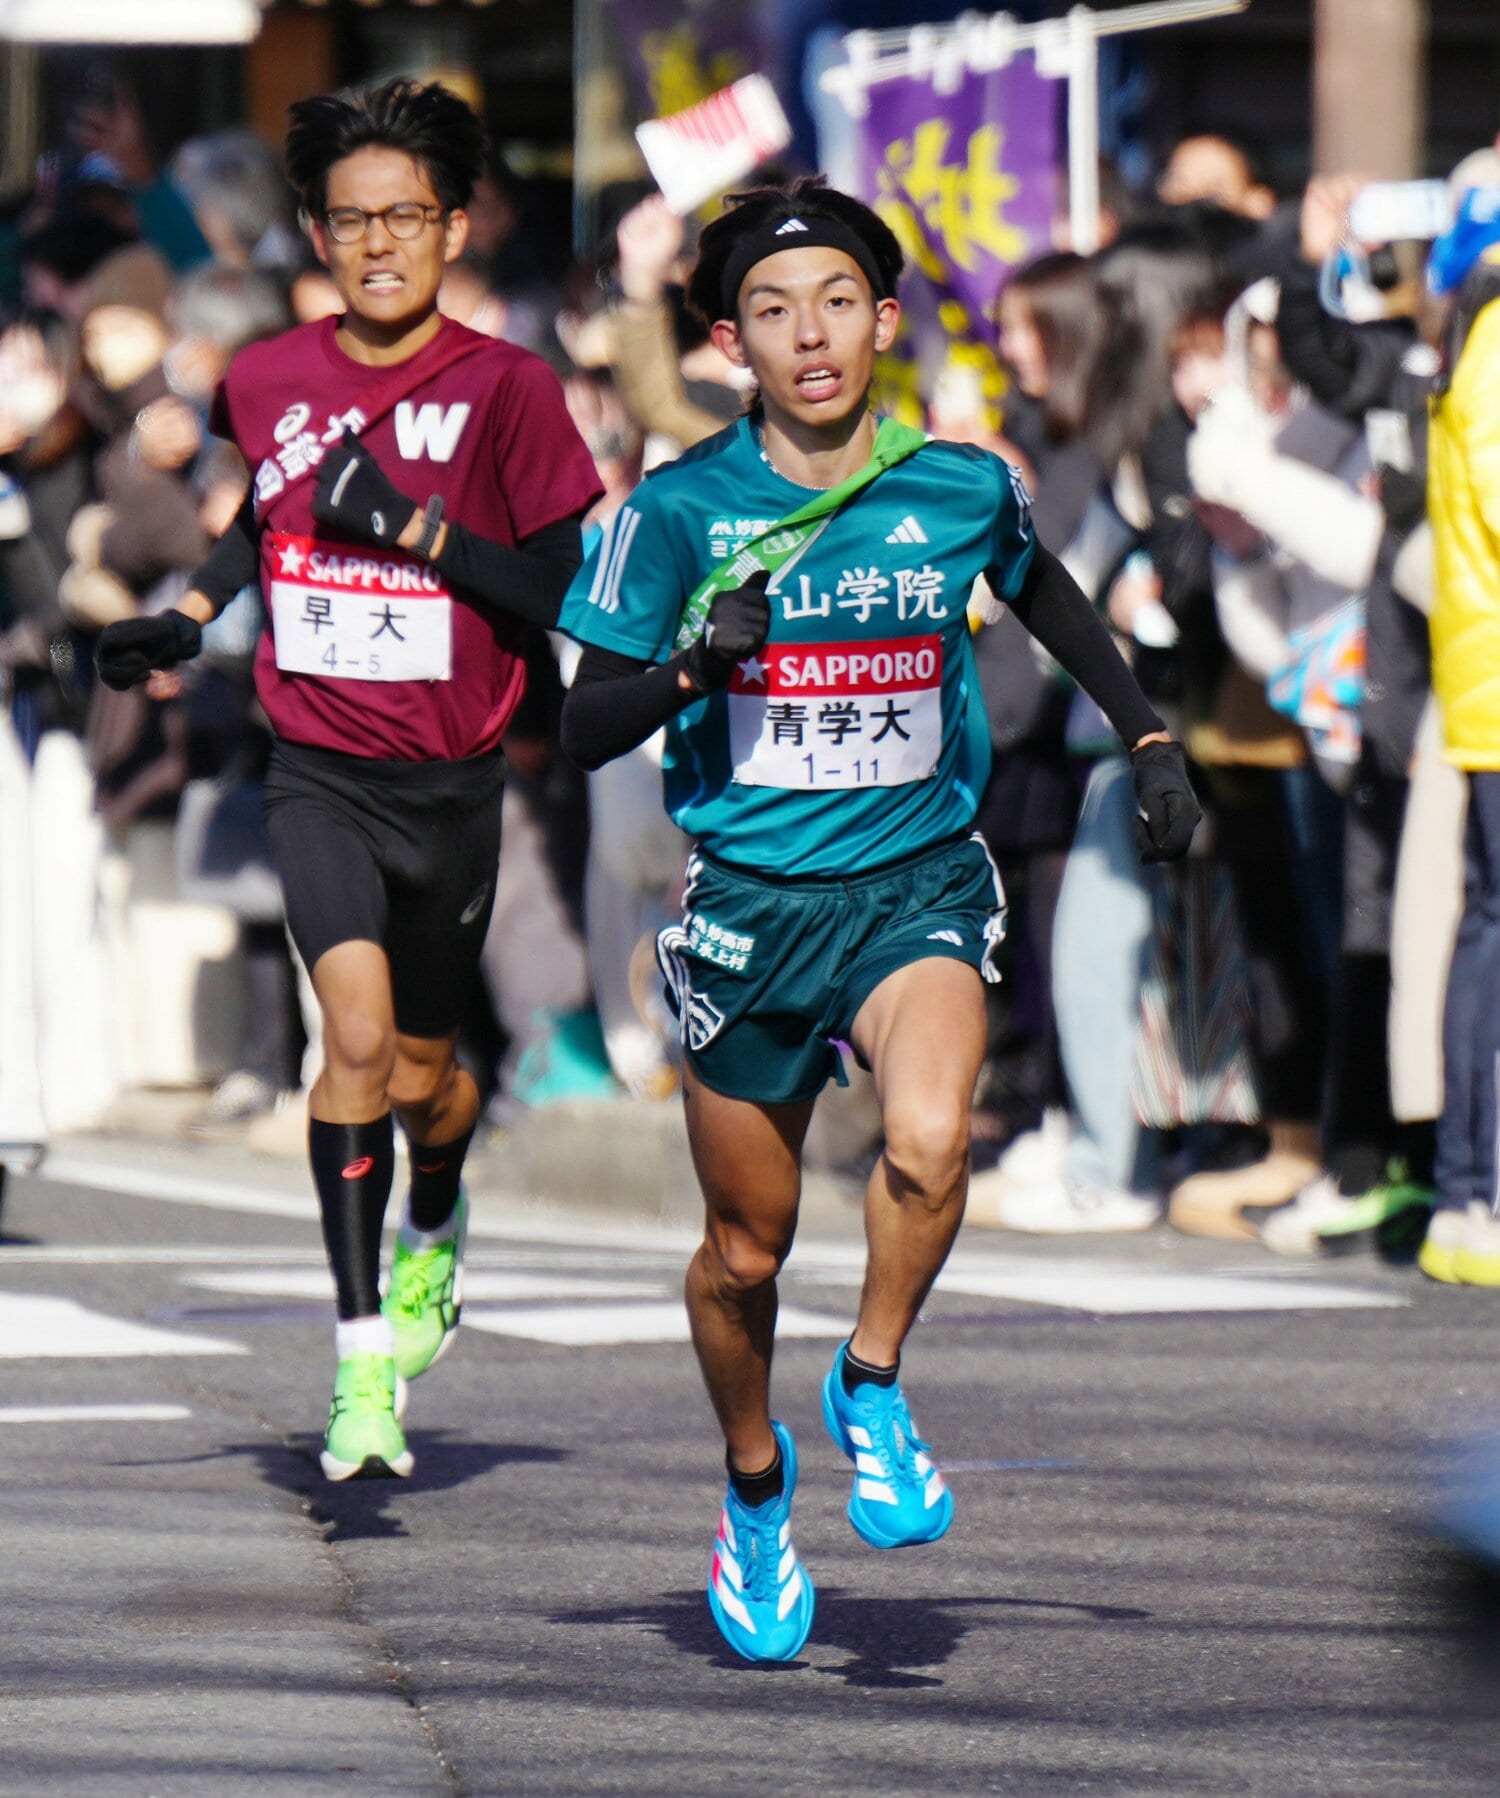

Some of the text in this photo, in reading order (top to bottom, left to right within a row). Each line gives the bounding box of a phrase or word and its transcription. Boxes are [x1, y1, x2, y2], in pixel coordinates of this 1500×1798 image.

[394, 400, 471, 462] W
[306, 551, 441, 592] SAPPORO
[768, 564, 949, 623] 山学院
[778, 649, 936, 687] SAPPORO
[766, 699, 912, 746] 青学大
